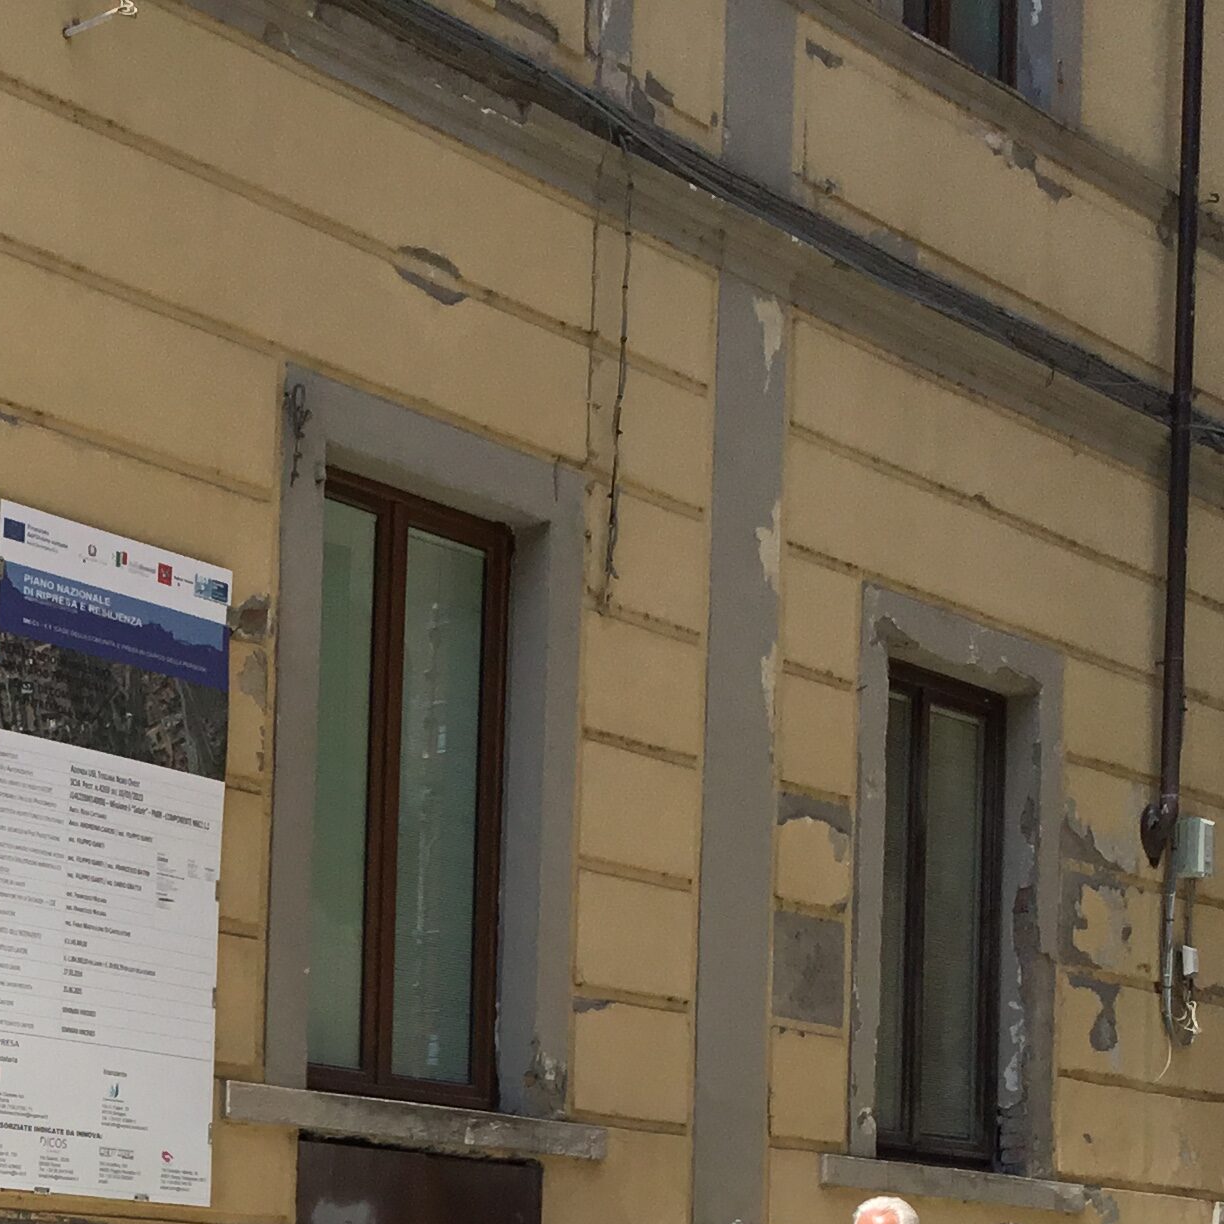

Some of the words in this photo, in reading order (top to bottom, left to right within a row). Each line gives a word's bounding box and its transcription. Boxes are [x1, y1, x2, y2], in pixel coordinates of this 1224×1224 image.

[23, 574, 55, 590] PIANO
[57, 583, 111, 607] NAZIONALE
[23, 586, 34, 596] DI
[36, 590, 78, 609] RIPRESA
[80, 602, 86, 612] E
[88, 604, 143, 628] RESILIENZA
[34, 1126, 64, 1136] INDICATE
[65, 1129, 75, 1137] DA
